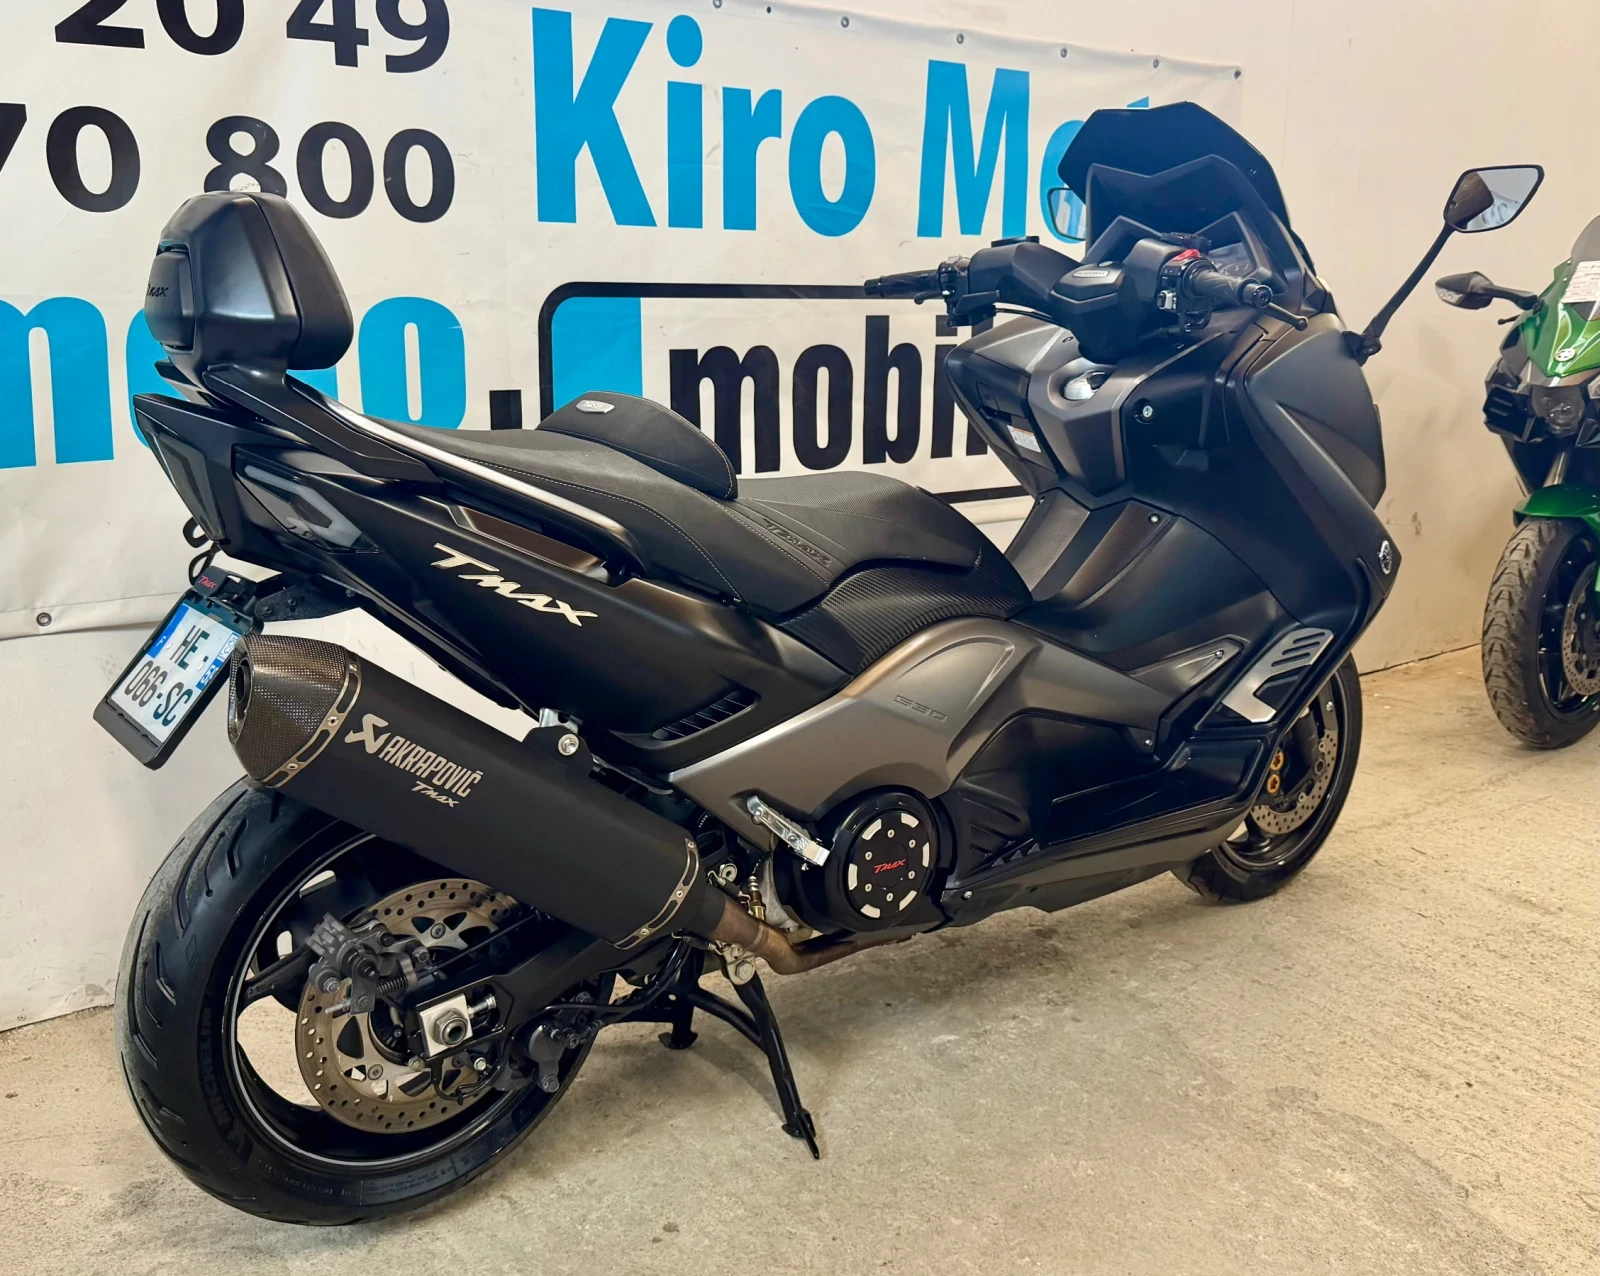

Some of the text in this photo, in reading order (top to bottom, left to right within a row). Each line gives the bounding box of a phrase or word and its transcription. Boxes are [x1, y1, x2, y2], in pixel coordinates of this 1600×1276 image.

[203, 115, 456, 223] 800
[532, 7, 876, 237] Kiro
[430, 542, 599, 627] TMAX
